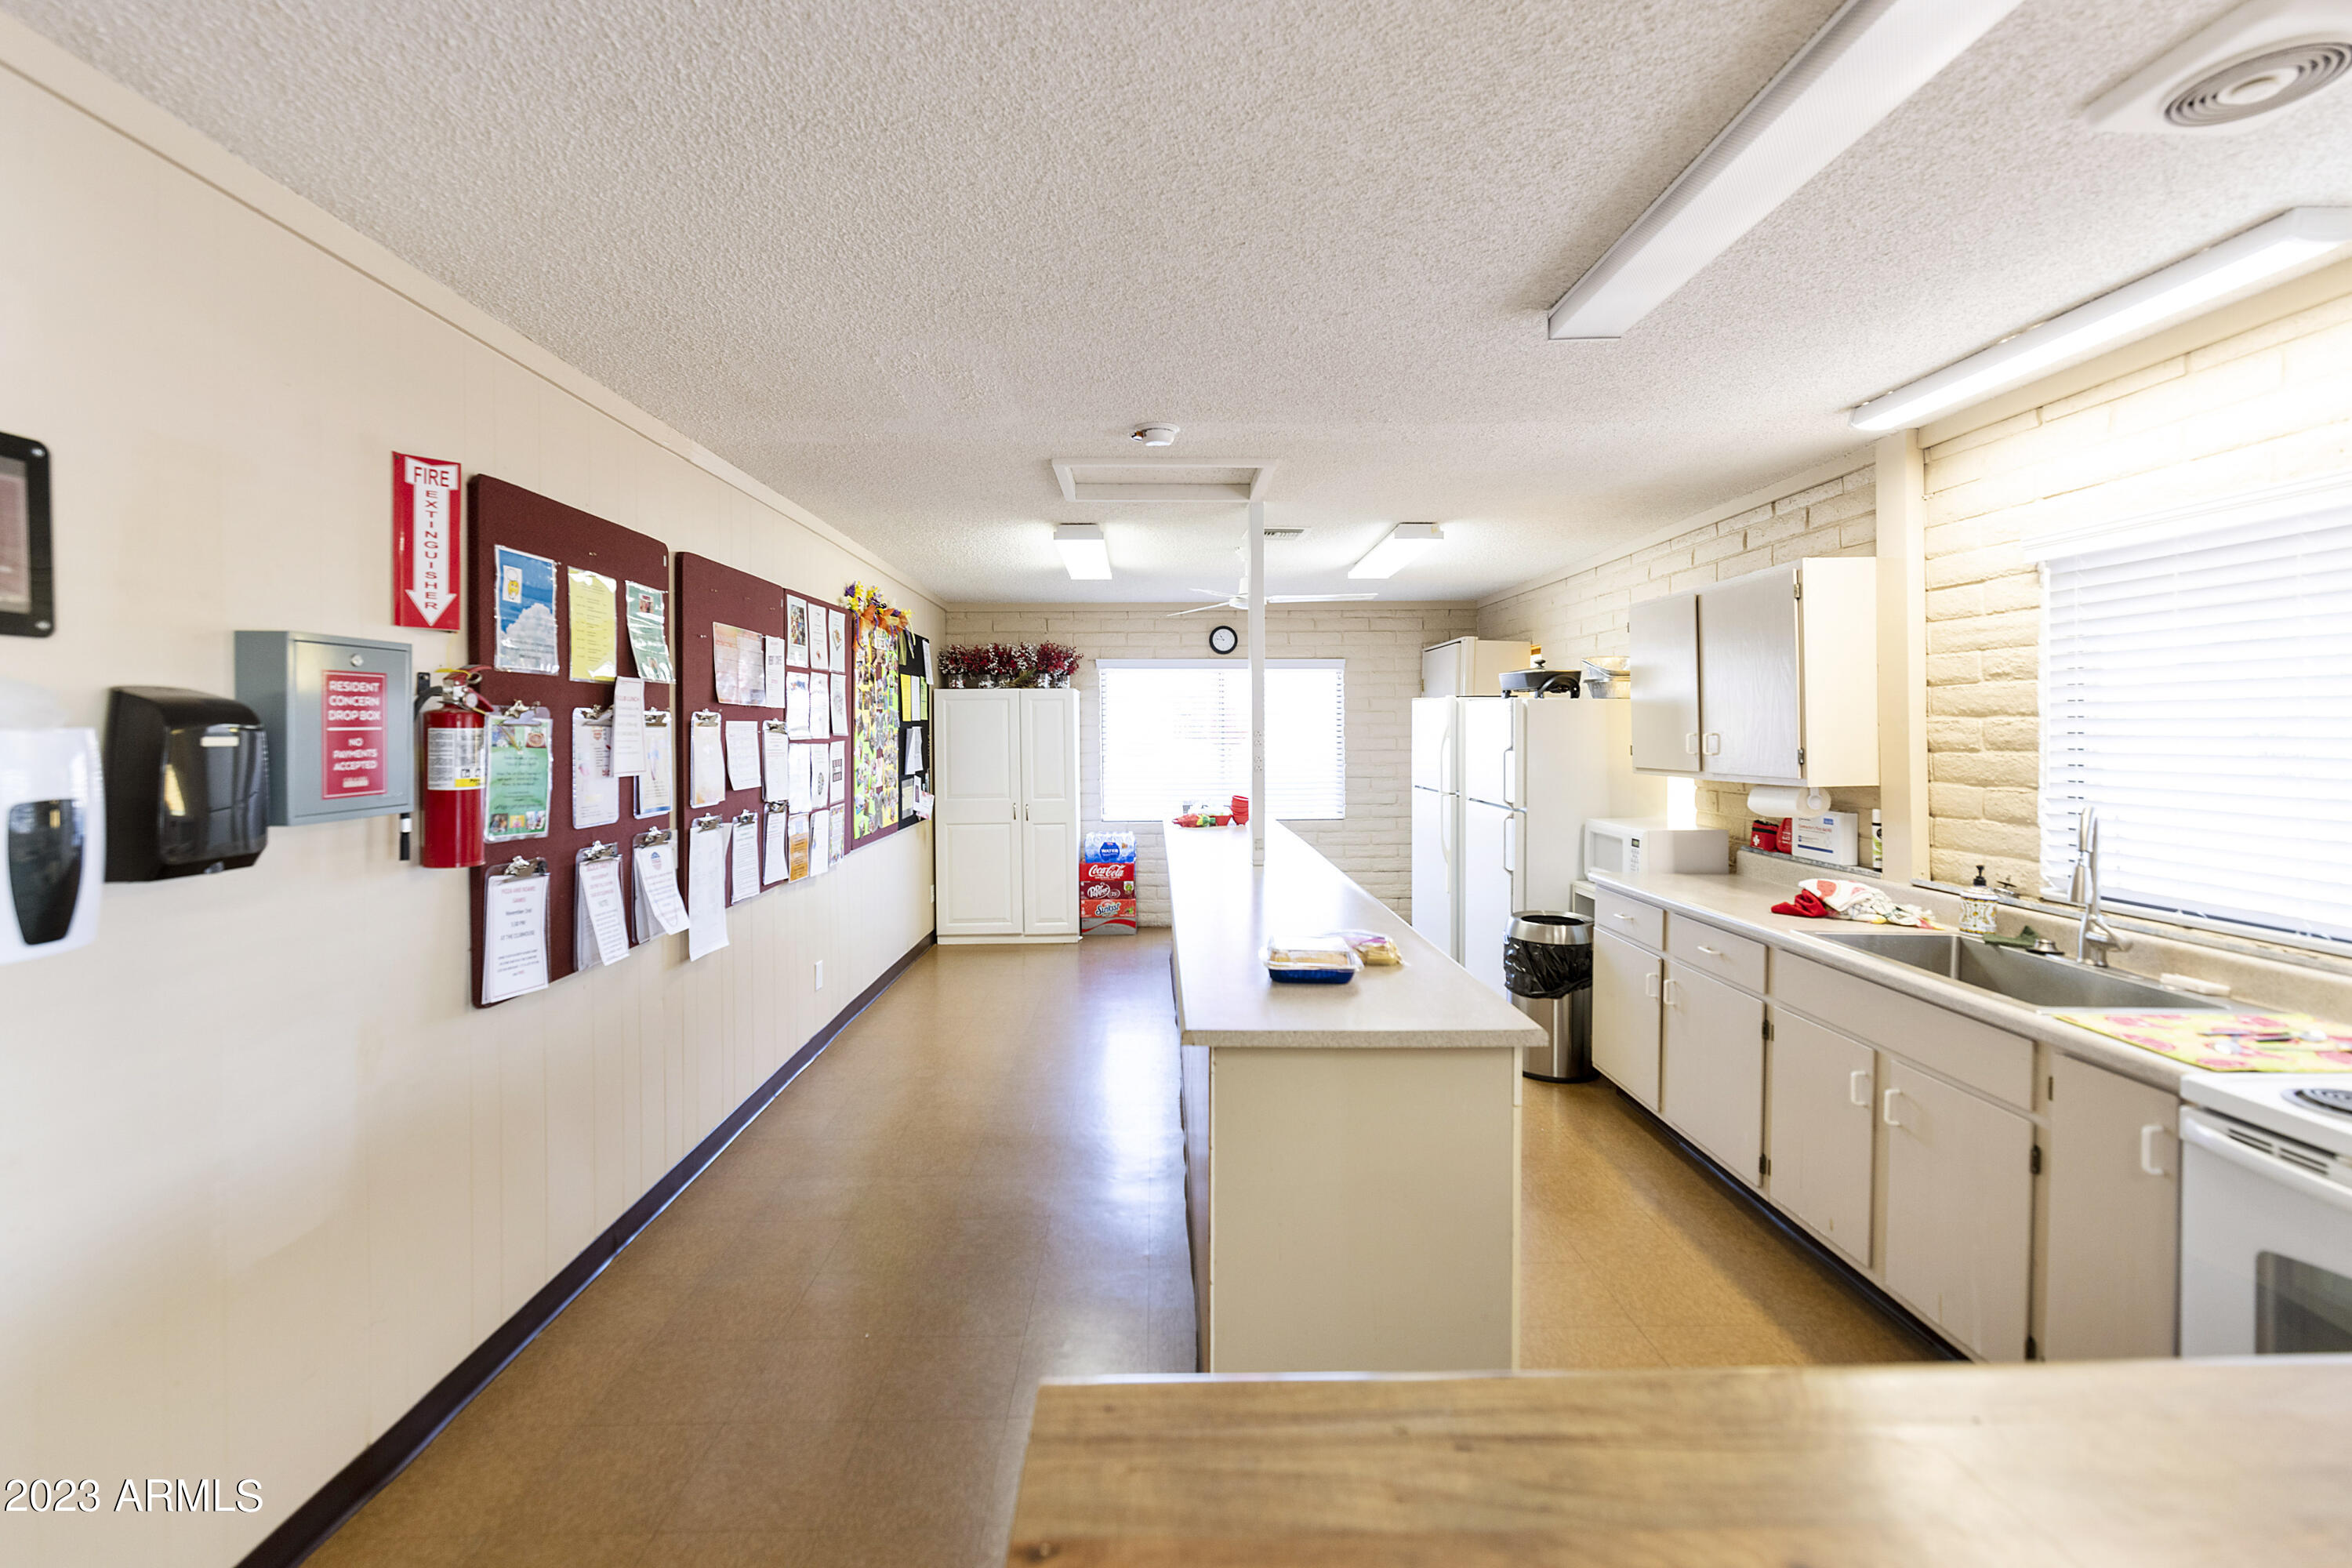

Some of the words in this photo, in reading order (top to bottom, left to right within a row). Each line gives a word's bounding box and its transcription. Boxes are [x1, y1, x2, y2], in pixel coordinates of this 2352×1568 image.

[413, 466, 449, 487] FIRE
[424, 490, 437, 610] EXTINGUISHER
[328, 681, 380, 692] RESIDENT
[328, 695, 380, 706] CONCERN
[328, 710, 358, 720] DROP
[359, 710, 381, 720] BOX
[348, 738, 363, 746] NO
[332, 749, 378, 759] PAYMENTS
[333, 760, 378, 771] ACCEPTED
[1088, 864, 1126, 877] Coca-Cola
[1095, 902, 1121, 916] Sunkist
